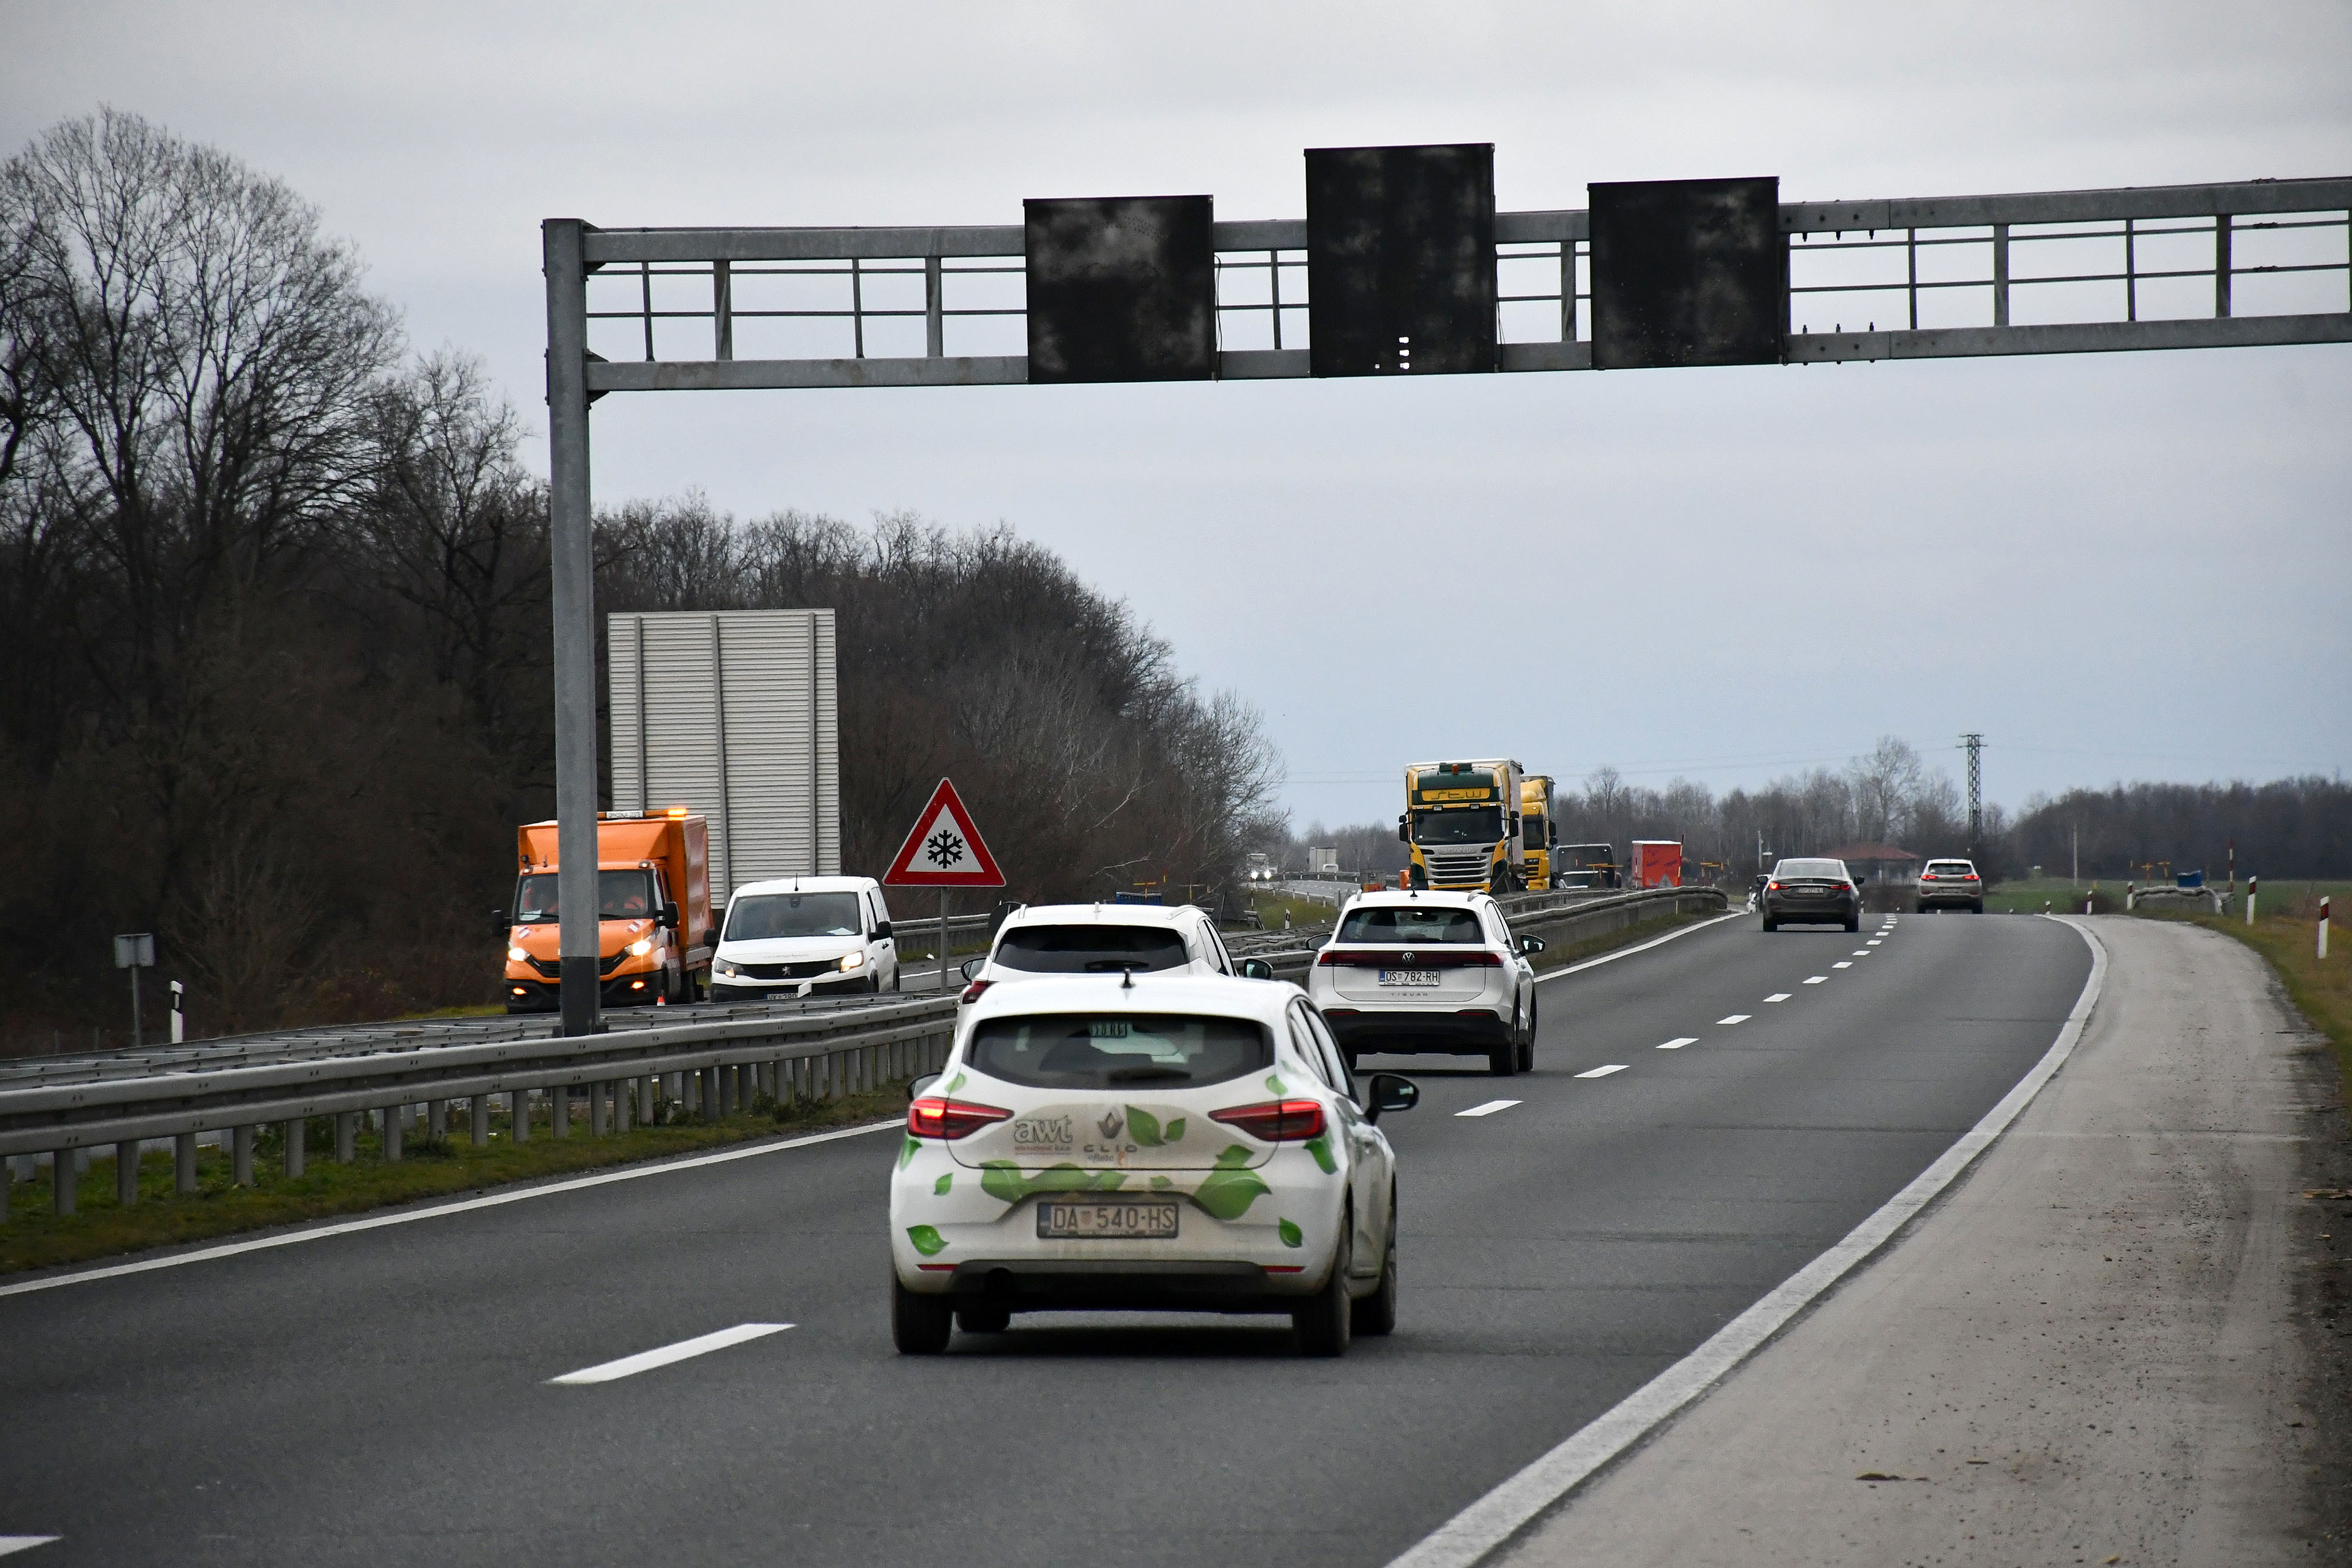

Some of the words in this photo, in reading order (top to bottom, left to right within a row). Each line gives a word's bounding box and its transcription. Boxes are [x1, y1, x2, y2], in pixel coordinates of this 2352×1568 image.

[1386, 972, 1397, 981] OS
[1404, 972, 1438, 981] 782-RH
[1014, 1115, 1073, 1144] awt
[1084, 1144, 1138, 1153] CLIO
[1054, 1207, 1078, 1229] DA
[1097, 1206, 1175, 1229] 540-HS
